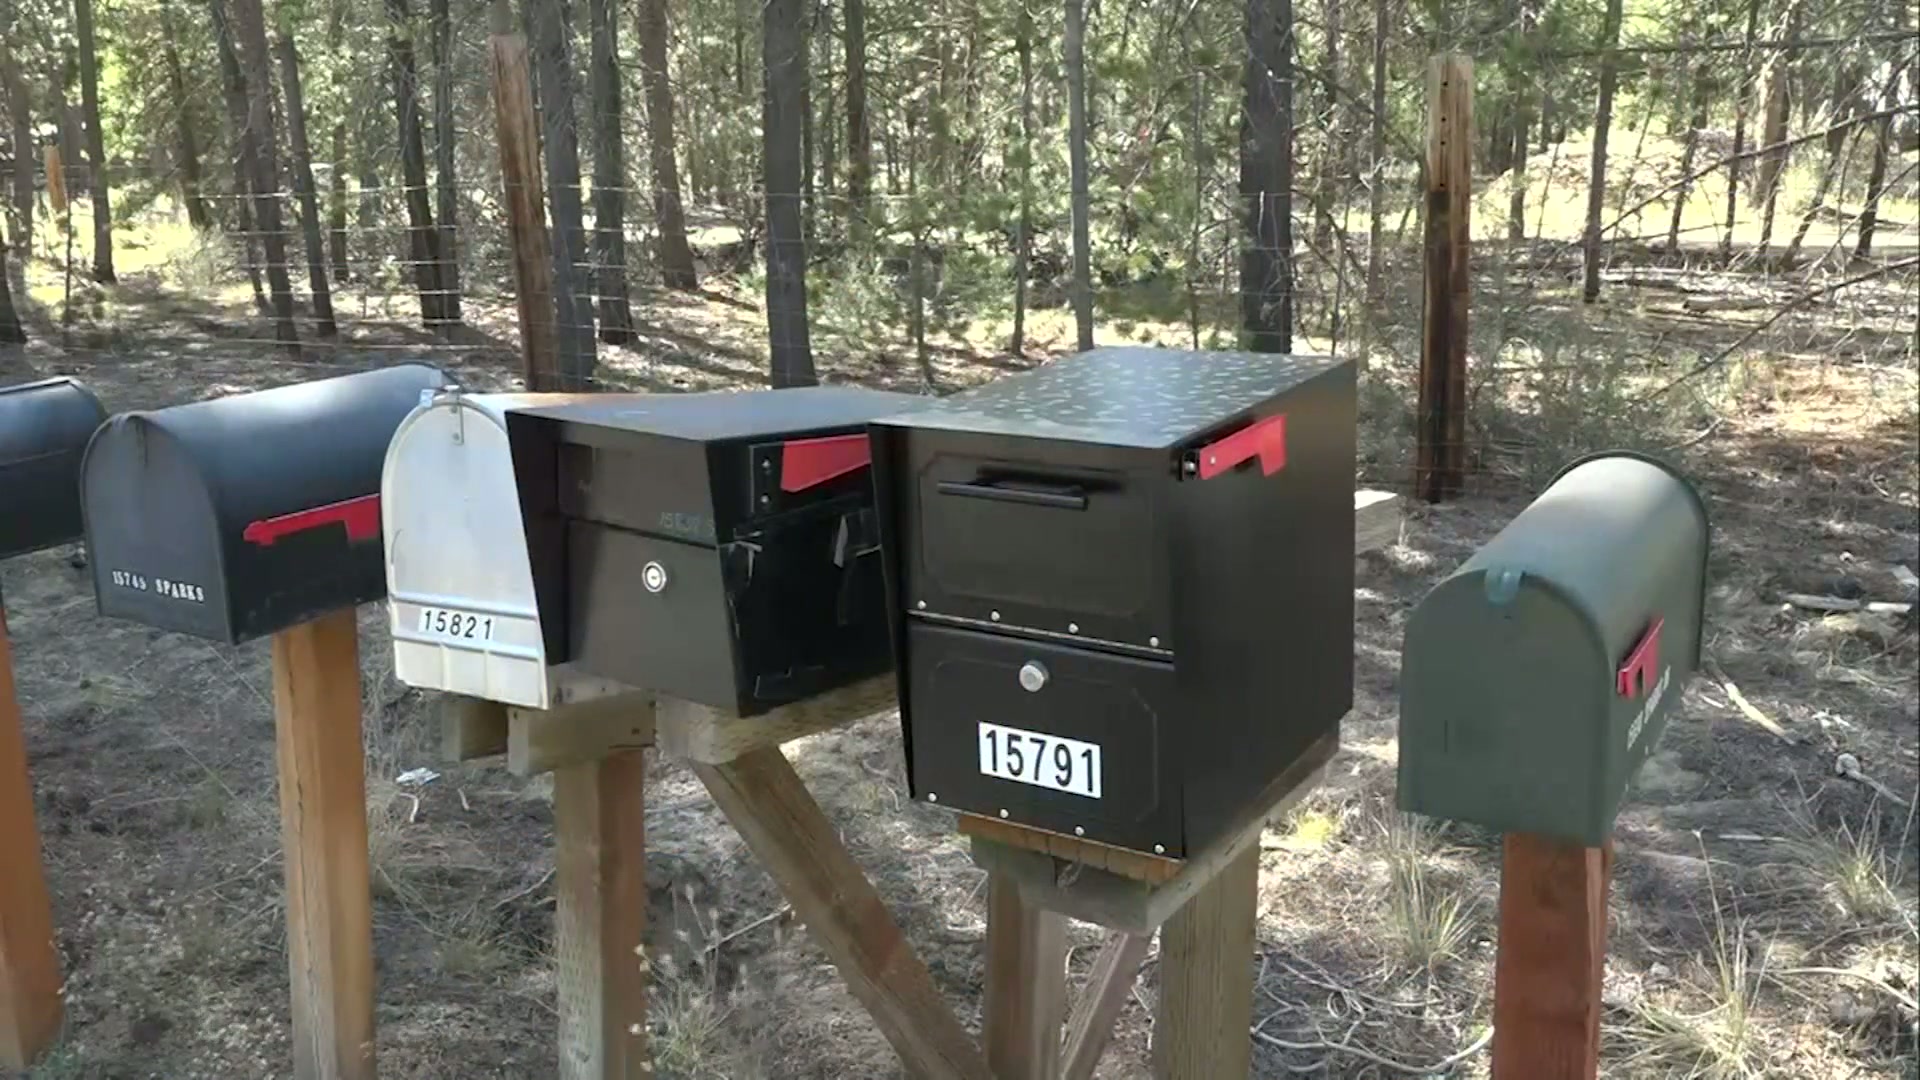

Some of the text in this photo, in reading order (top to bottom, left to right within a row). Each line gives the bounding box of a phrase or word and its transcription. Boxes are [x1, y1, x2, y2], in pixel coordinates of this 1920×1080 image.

[155, 579, 204, 601] SPARKS
[425, 610, 491, 639] 15821
[986, 729, 1093, 793] 15791
